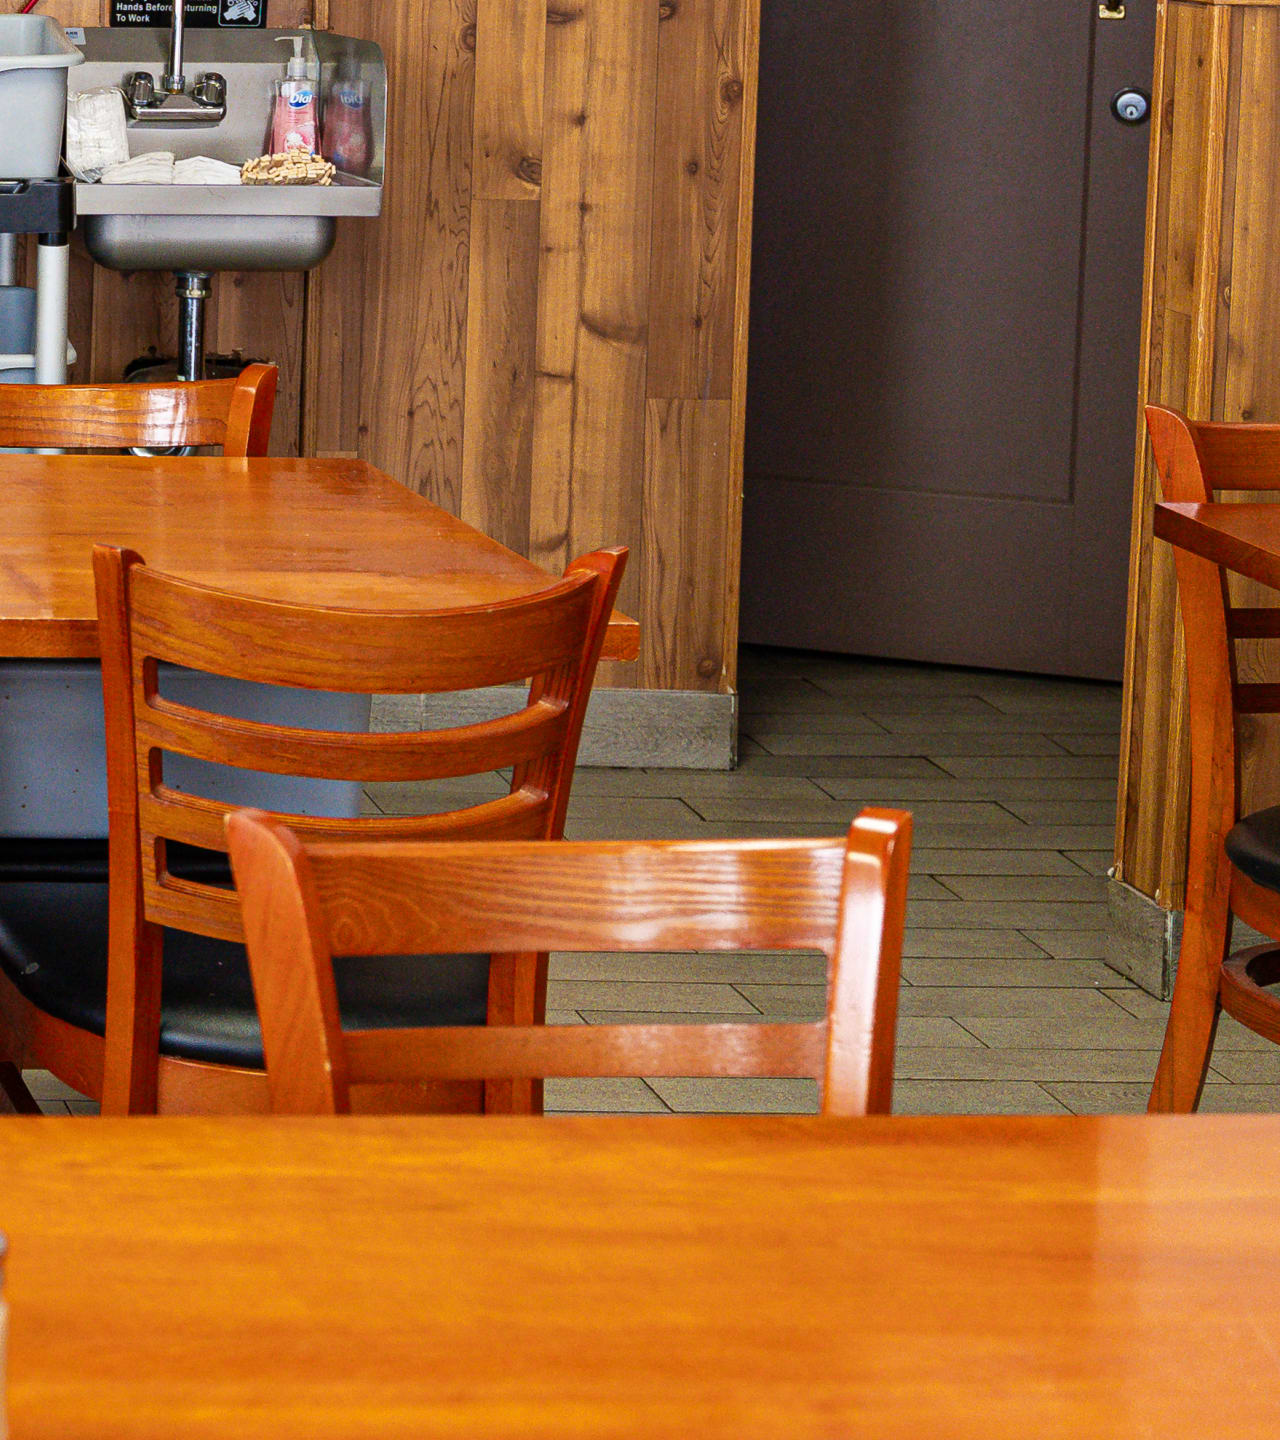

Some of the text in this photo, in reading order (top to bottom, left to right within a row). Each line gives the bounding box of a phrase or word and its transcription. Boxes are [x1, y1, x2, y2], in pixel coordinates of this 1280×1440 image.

[116, 3, 143, 11] Hands
[116, 13, 150, 22] To Work
[289, 93, 313, 104] Dial
